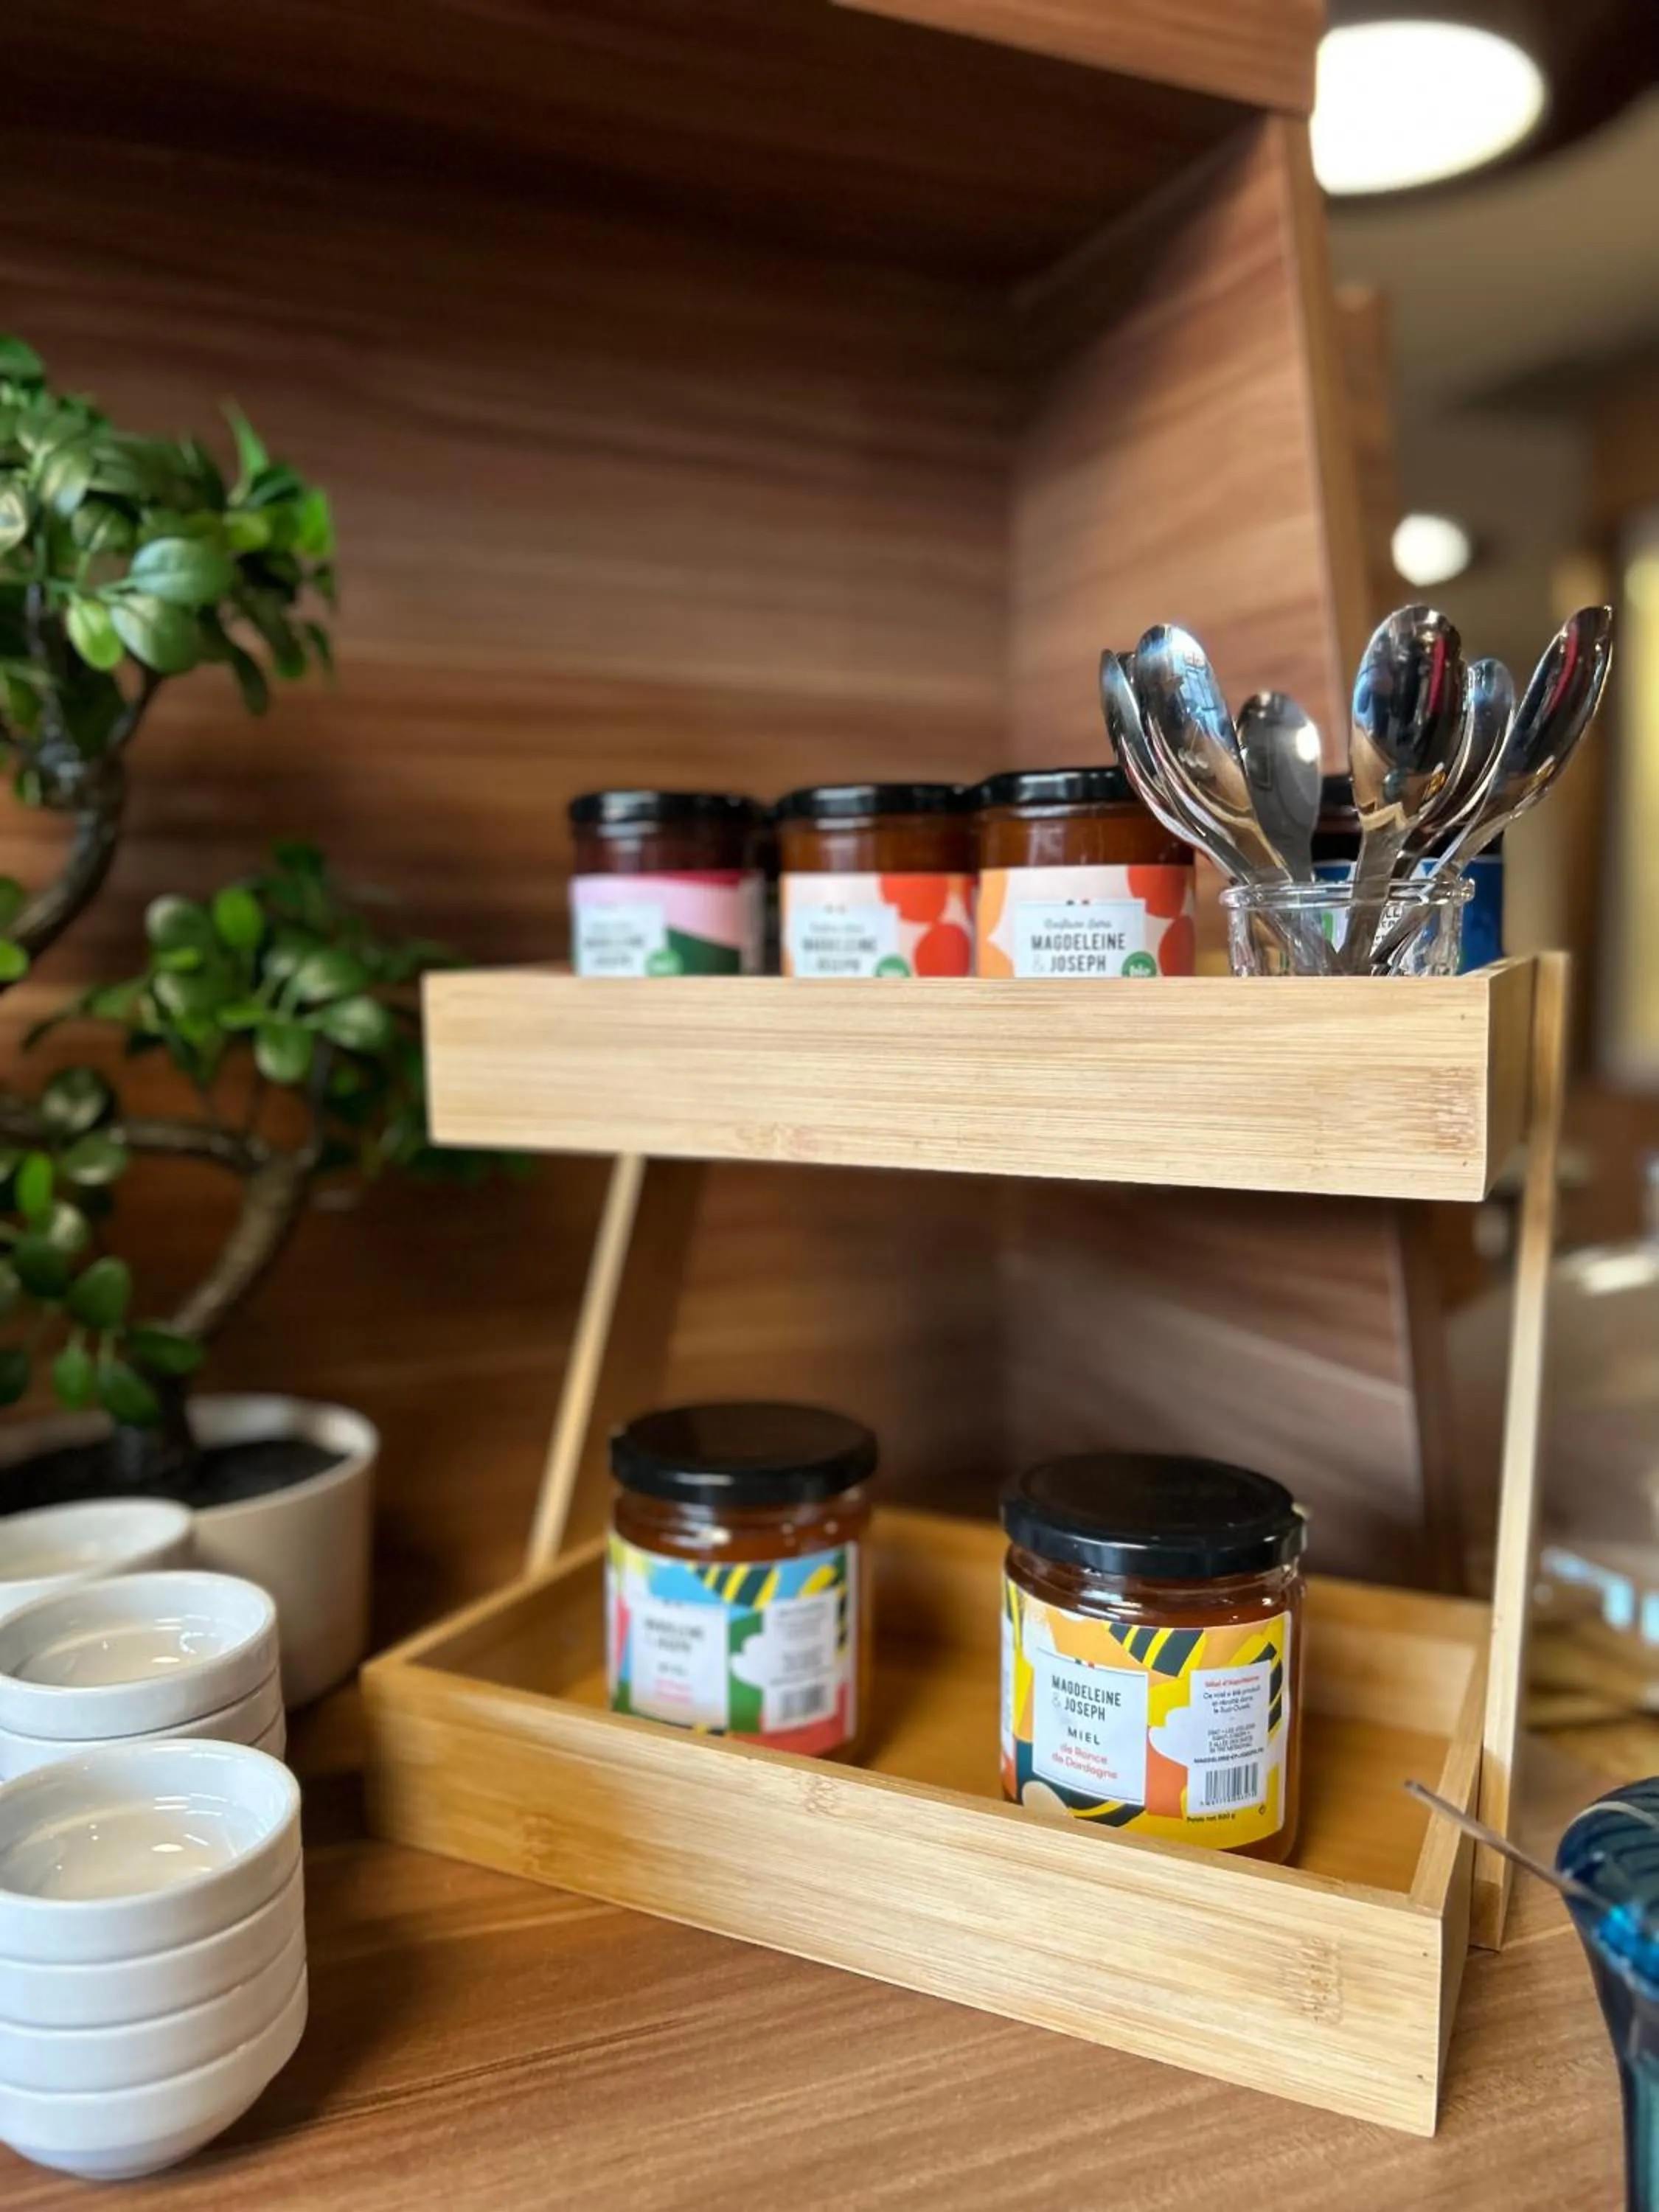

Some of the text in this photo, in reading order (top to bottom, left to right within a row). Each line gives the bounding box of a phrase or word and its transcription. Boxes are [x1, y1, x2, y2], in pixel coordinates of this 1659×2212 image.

[1031, 933, 1126, 950] MAGDELEINE
[1051, 955, 1106, 973] JOSEPH
[1051, 1674, 1121, 1707] MAGDELEINE
[1064, 1697, 1105, 1722] JOSEPH
[1067, 1725, 1101, 1745] MIEL
[1074, 1746, 1108, 1764] Ronce
[1065, 1756, 1118, 1780] Dordogne
